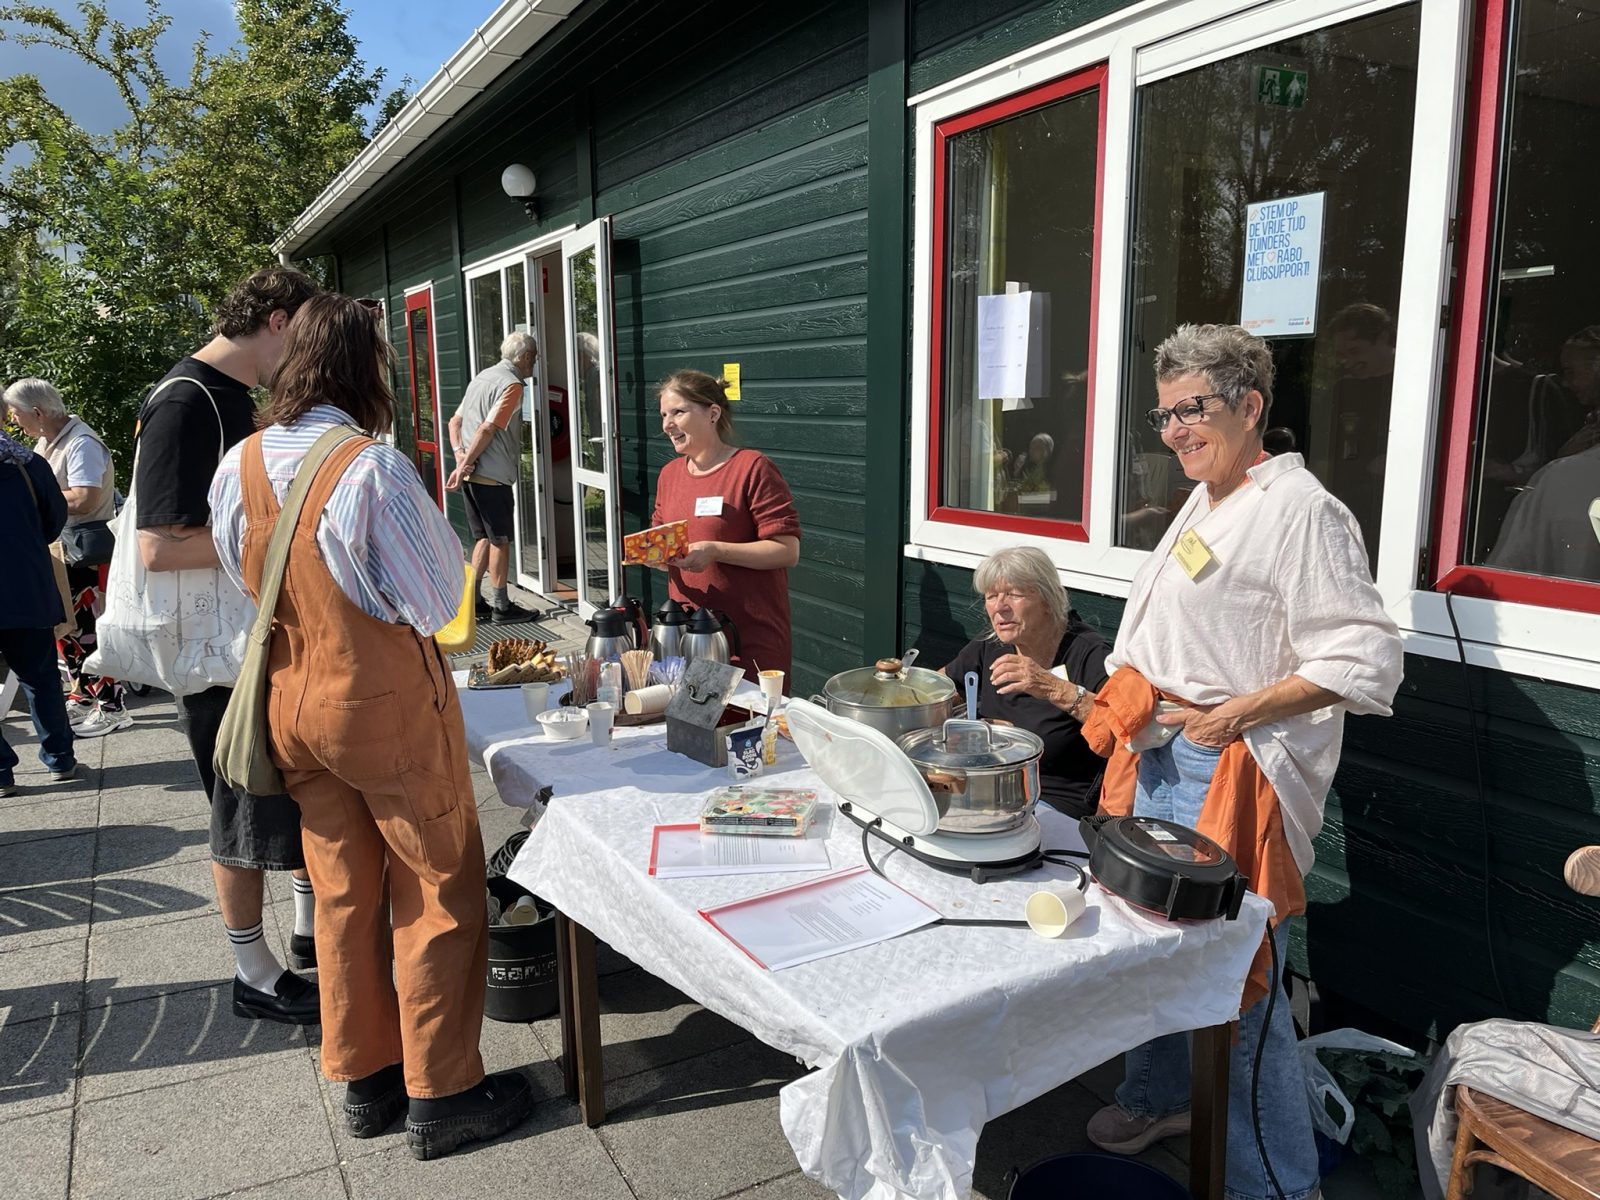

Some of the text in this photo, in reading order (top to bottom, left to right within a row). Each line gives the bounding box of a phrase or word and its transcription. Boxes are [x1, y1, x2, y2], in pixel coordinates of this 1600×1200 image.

[1260, 201, 1298, 220] STEM OP
[1249, 215, 1306, 238] DE VRIJE TIJD
[1249, 233, 1291, 252] TUINDERS
[1247, 247, 1302, 267] MET RABO
[1246, 261, 1310, 282] CLUBSUPPORT!
